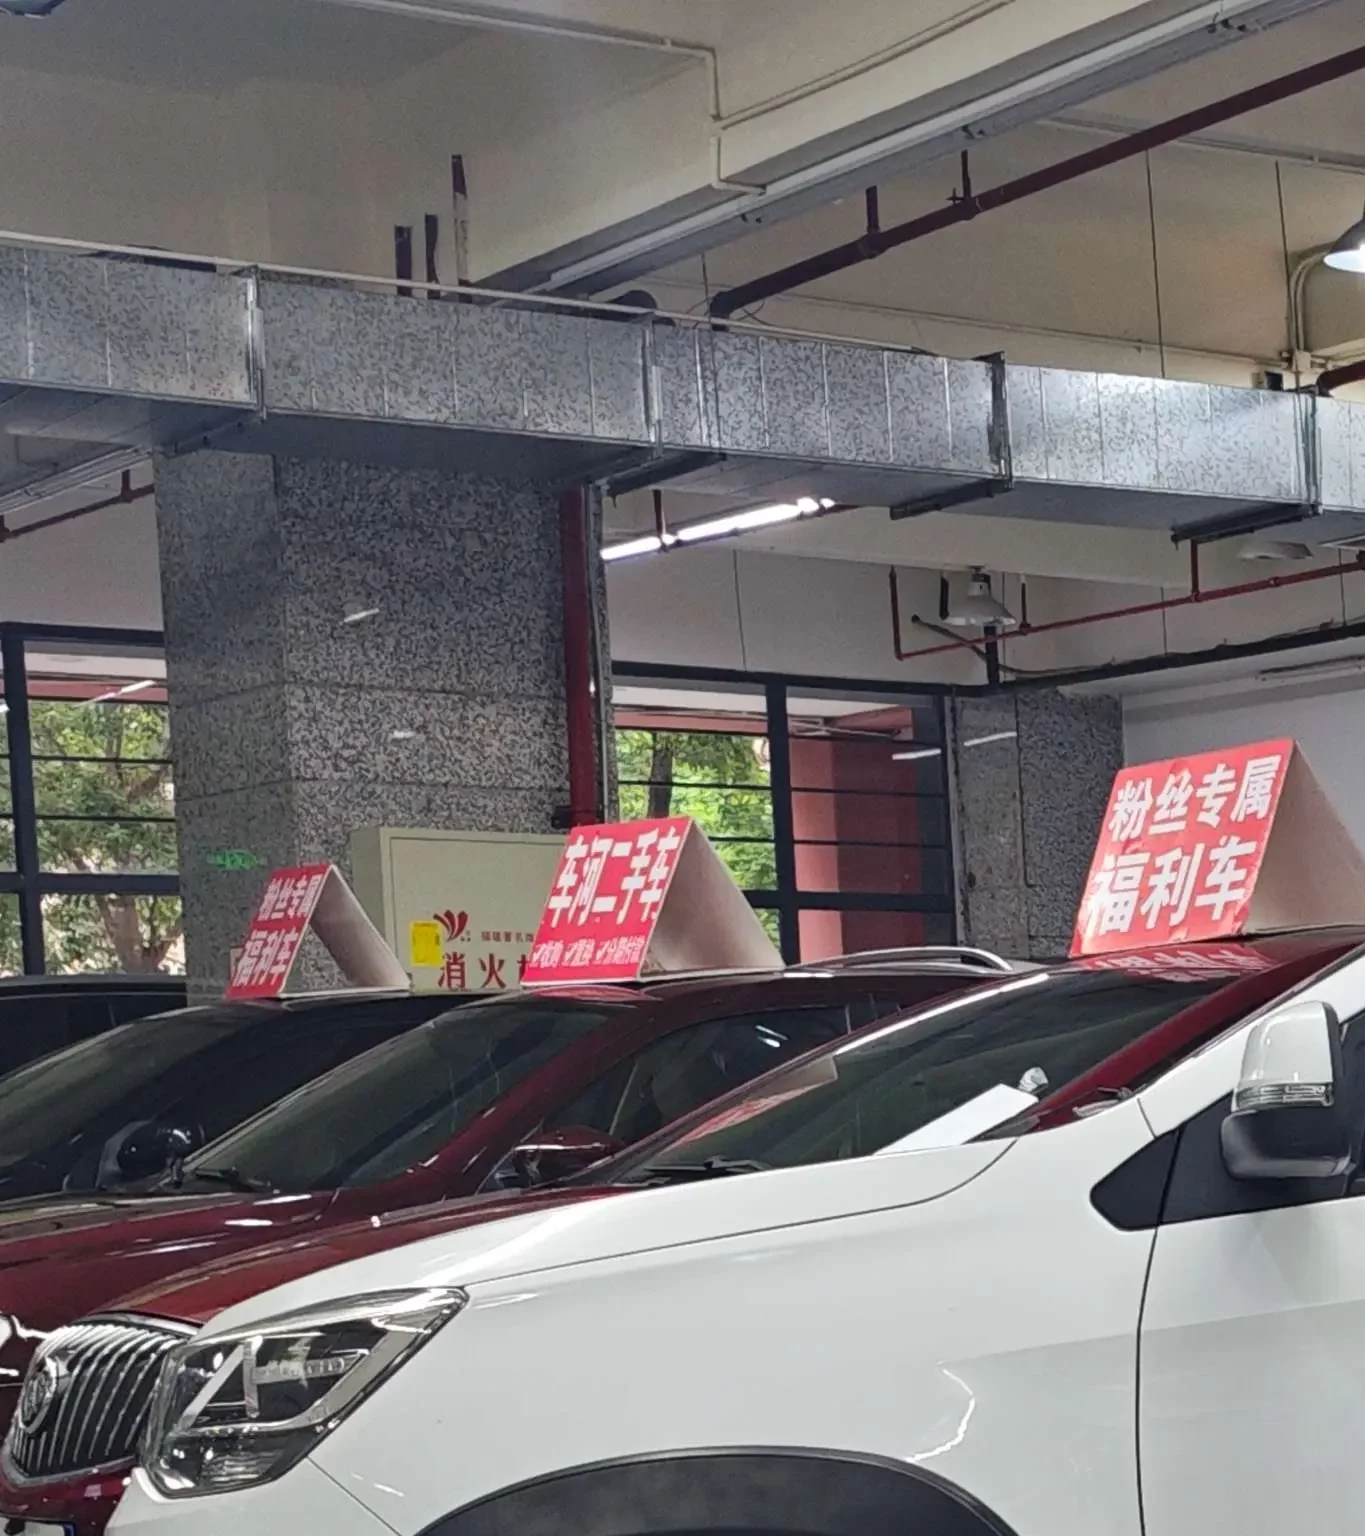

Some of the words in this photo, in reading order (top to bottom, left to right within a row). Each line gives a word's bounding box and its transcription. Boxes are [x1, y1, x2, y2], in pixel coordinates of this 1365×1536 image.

[1108, 755, 1282, 842] 粉丝专属
[257, 874, 324, 921] 粉丝专属
[1085, 835, 1257, 937] 福利车
[232, 926, 300, 987] 福利车
